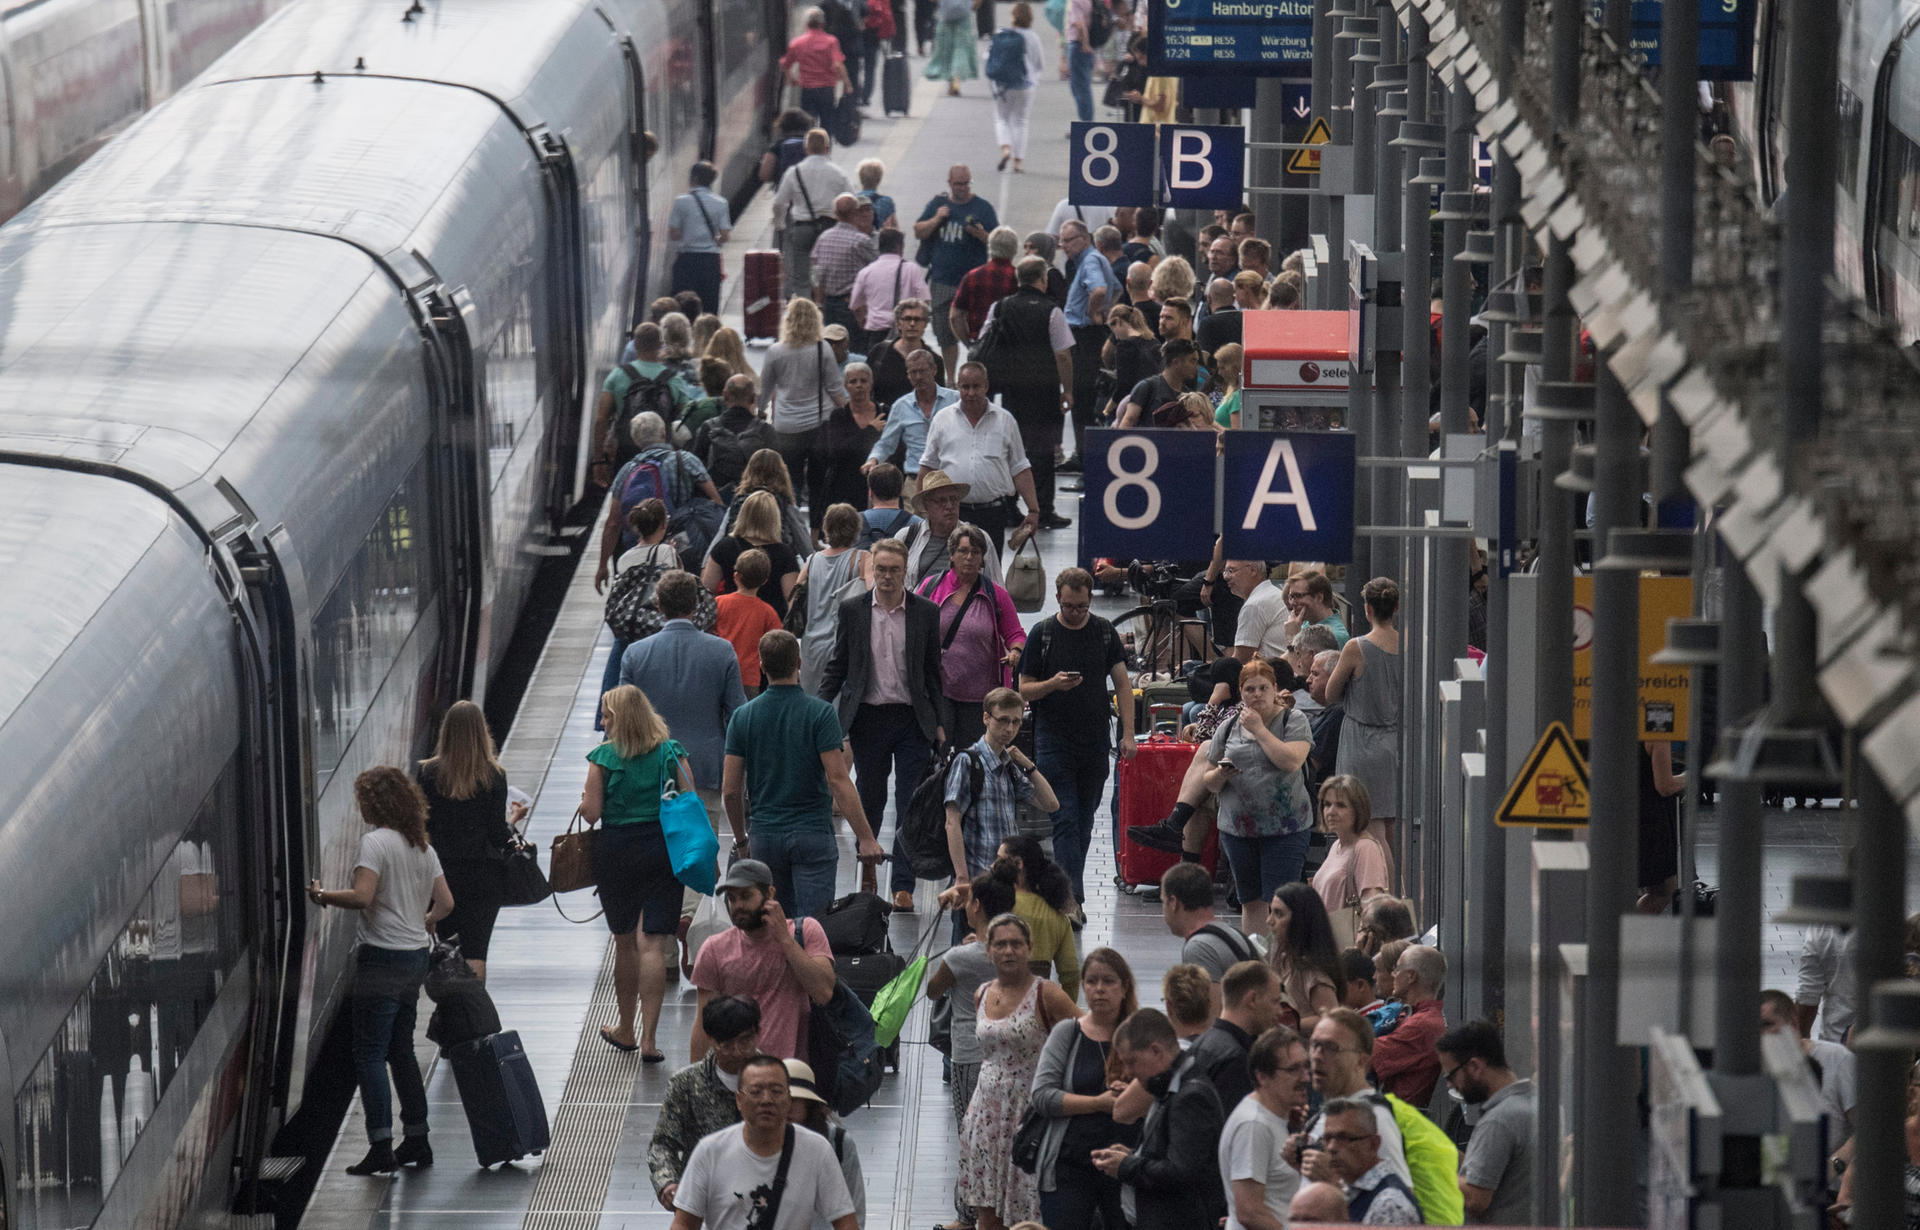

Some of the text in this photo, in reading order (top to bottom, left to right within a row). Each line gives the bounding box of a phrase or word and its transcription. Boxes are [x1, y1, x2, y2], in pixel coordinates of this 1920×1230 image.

[1165, 48, 1190, 59] 17:24
[1260, 51, 1279, 59] von
[1261, 35, 1307, 48] Würzburg
[1081, 126, 1213, 189] 8 B
[1103, 435, 1318, 531] 8 A
